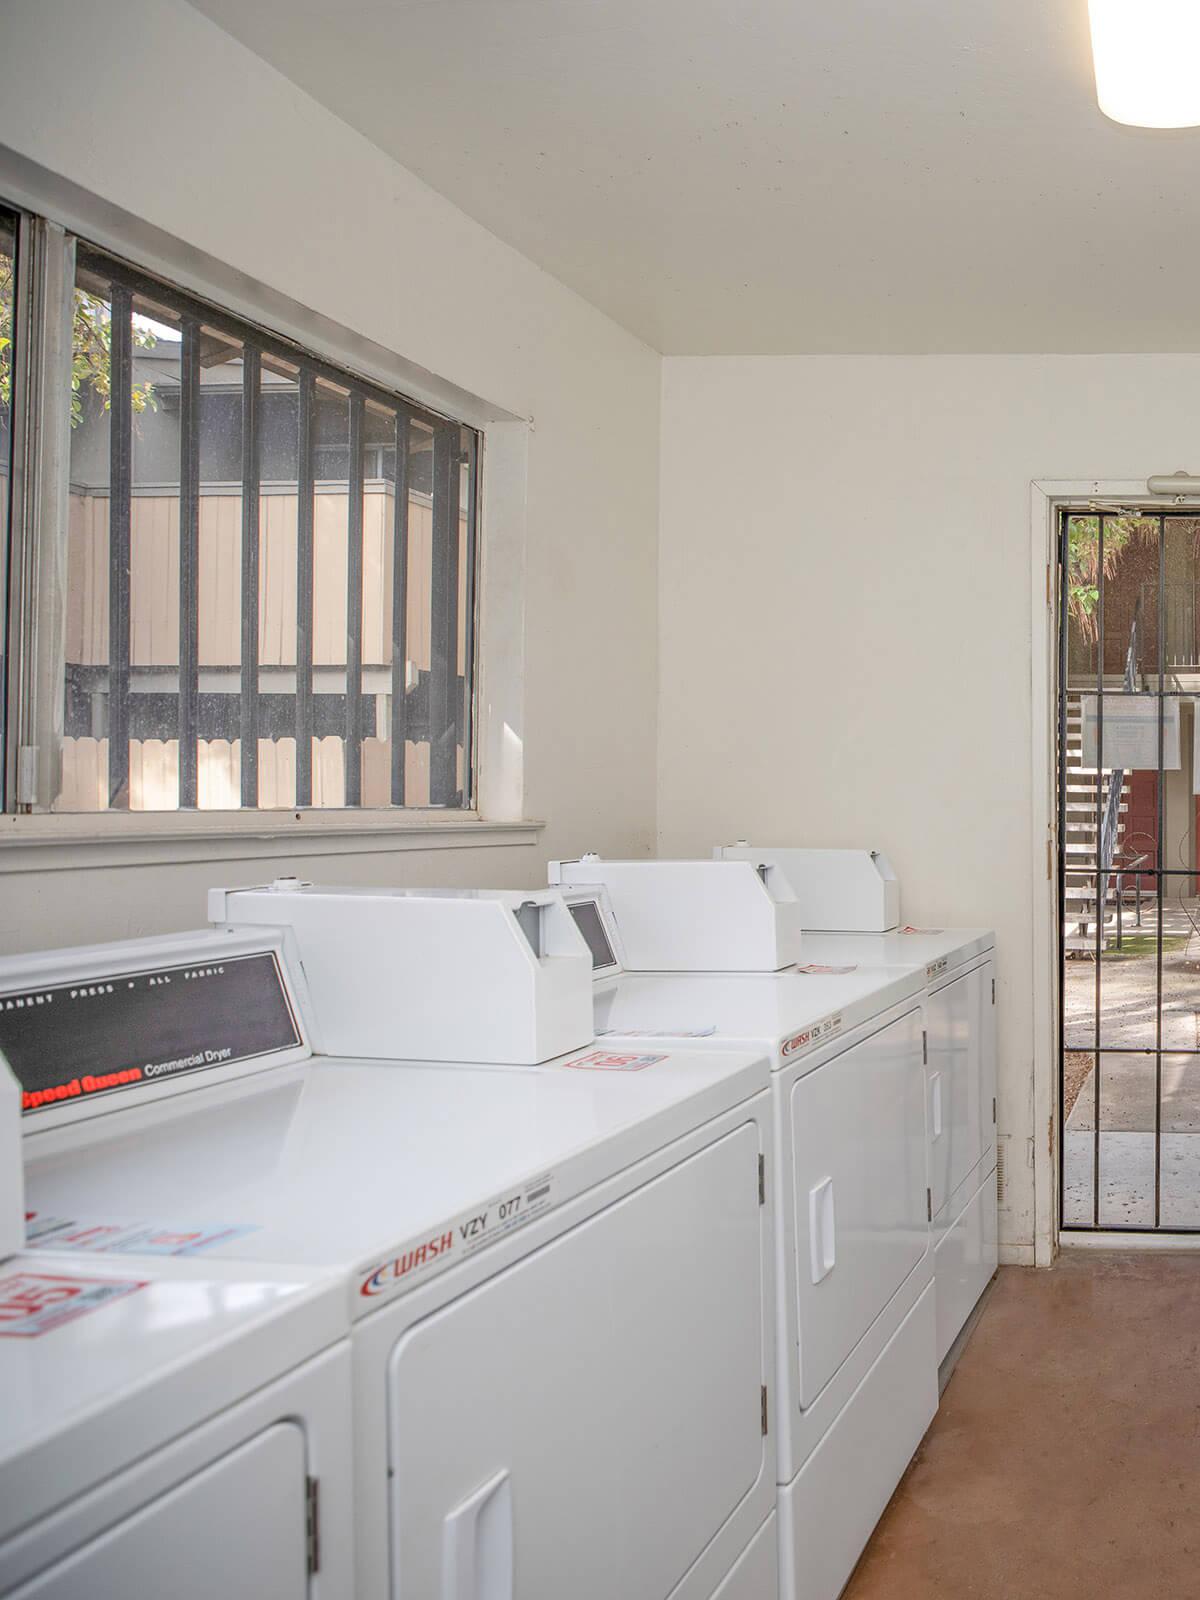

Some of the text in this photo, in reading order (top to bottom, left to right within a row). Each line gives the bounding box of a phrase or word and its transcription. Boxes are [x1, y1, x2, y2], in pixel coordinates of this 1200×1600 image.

[70, 984, 114, 999] PRESS
[149, 976, 171, 986] ALL
[184, 966, 225, 980] FABRIC
[791, 1031, 809, 1049] WASH
[22, 1047, 231, 1109] Speed Queen Commercial Dryer
[394, 1195, 521, 1279] WASH VZY 077
